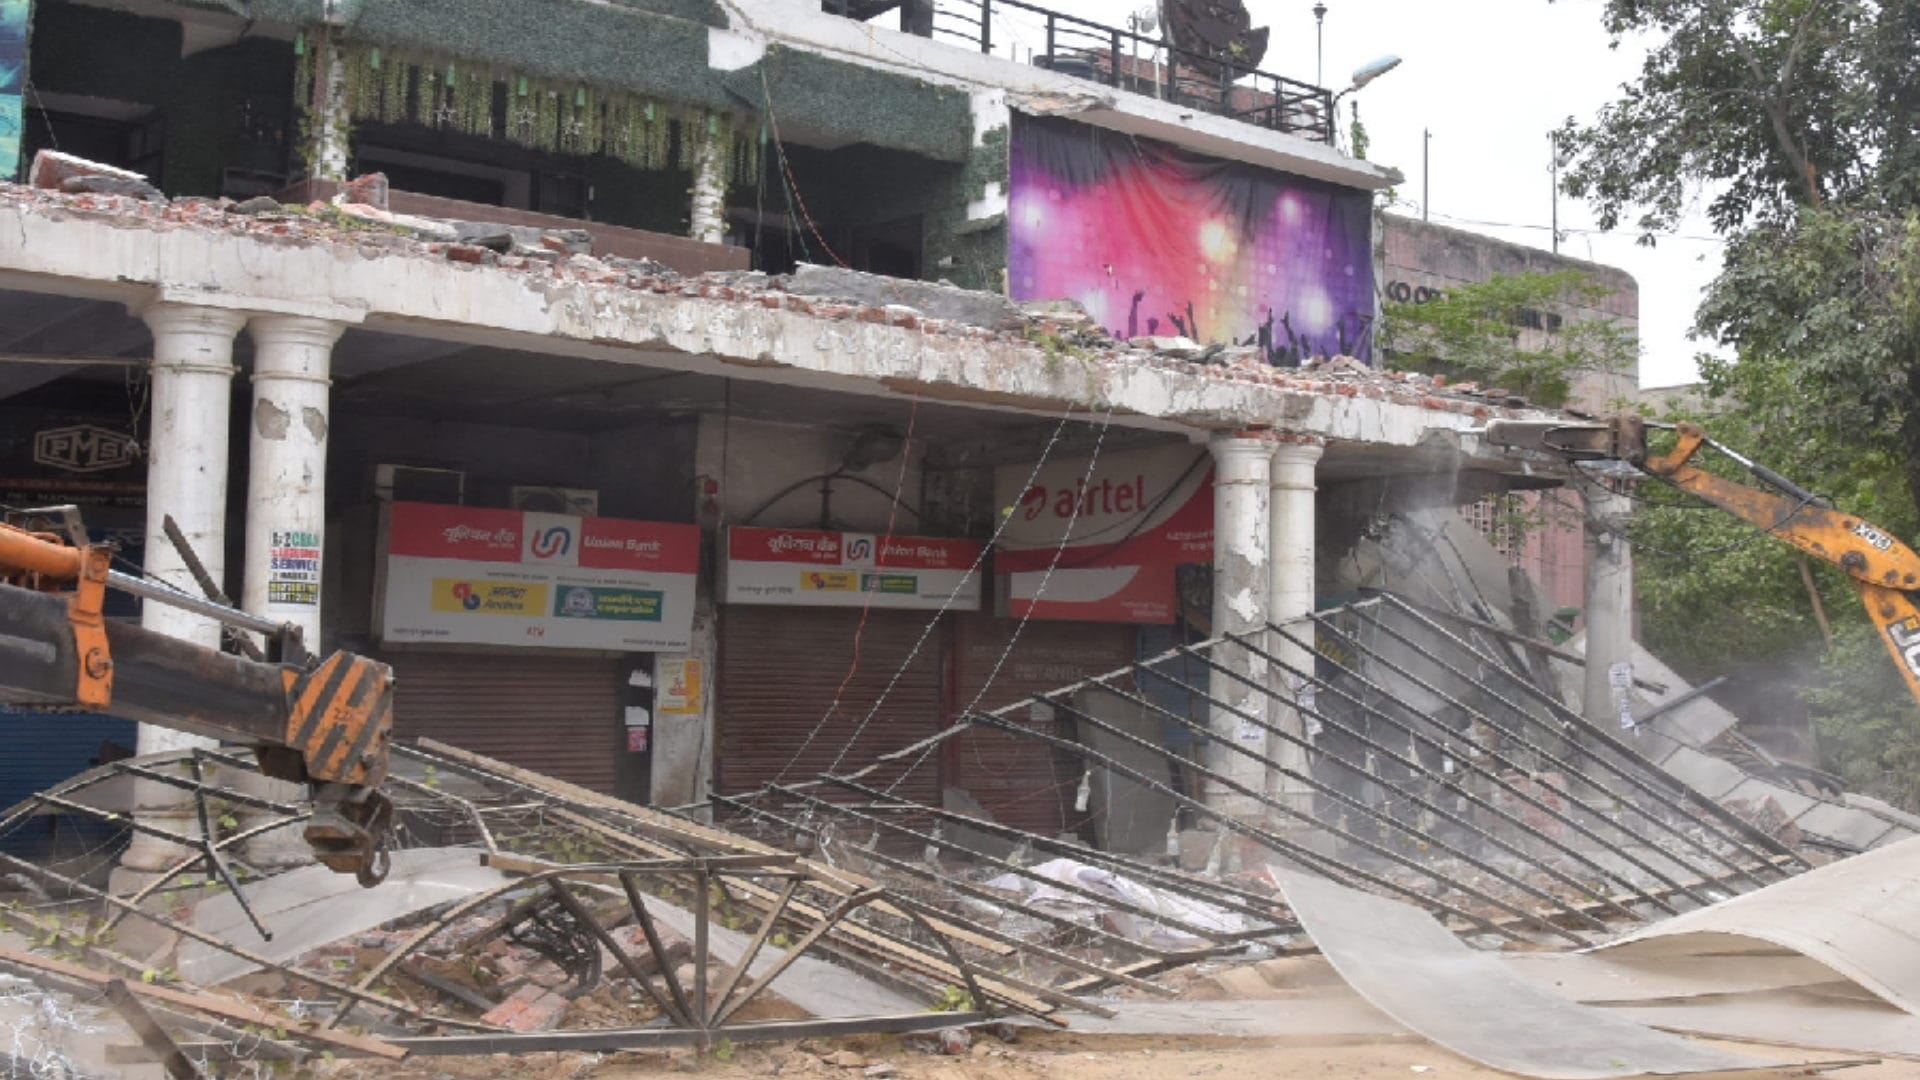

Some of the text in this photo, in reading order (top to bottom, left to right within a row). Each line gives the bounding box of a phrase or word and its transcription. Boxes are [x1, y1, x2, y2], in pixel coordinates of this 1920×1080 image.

[48, 431, 119, 466] PMS
[1054, 474, 1147, 519] airtel
[584, 535, 662, 551] Union Bank
[879, 543, 949, 559] Union Bank
